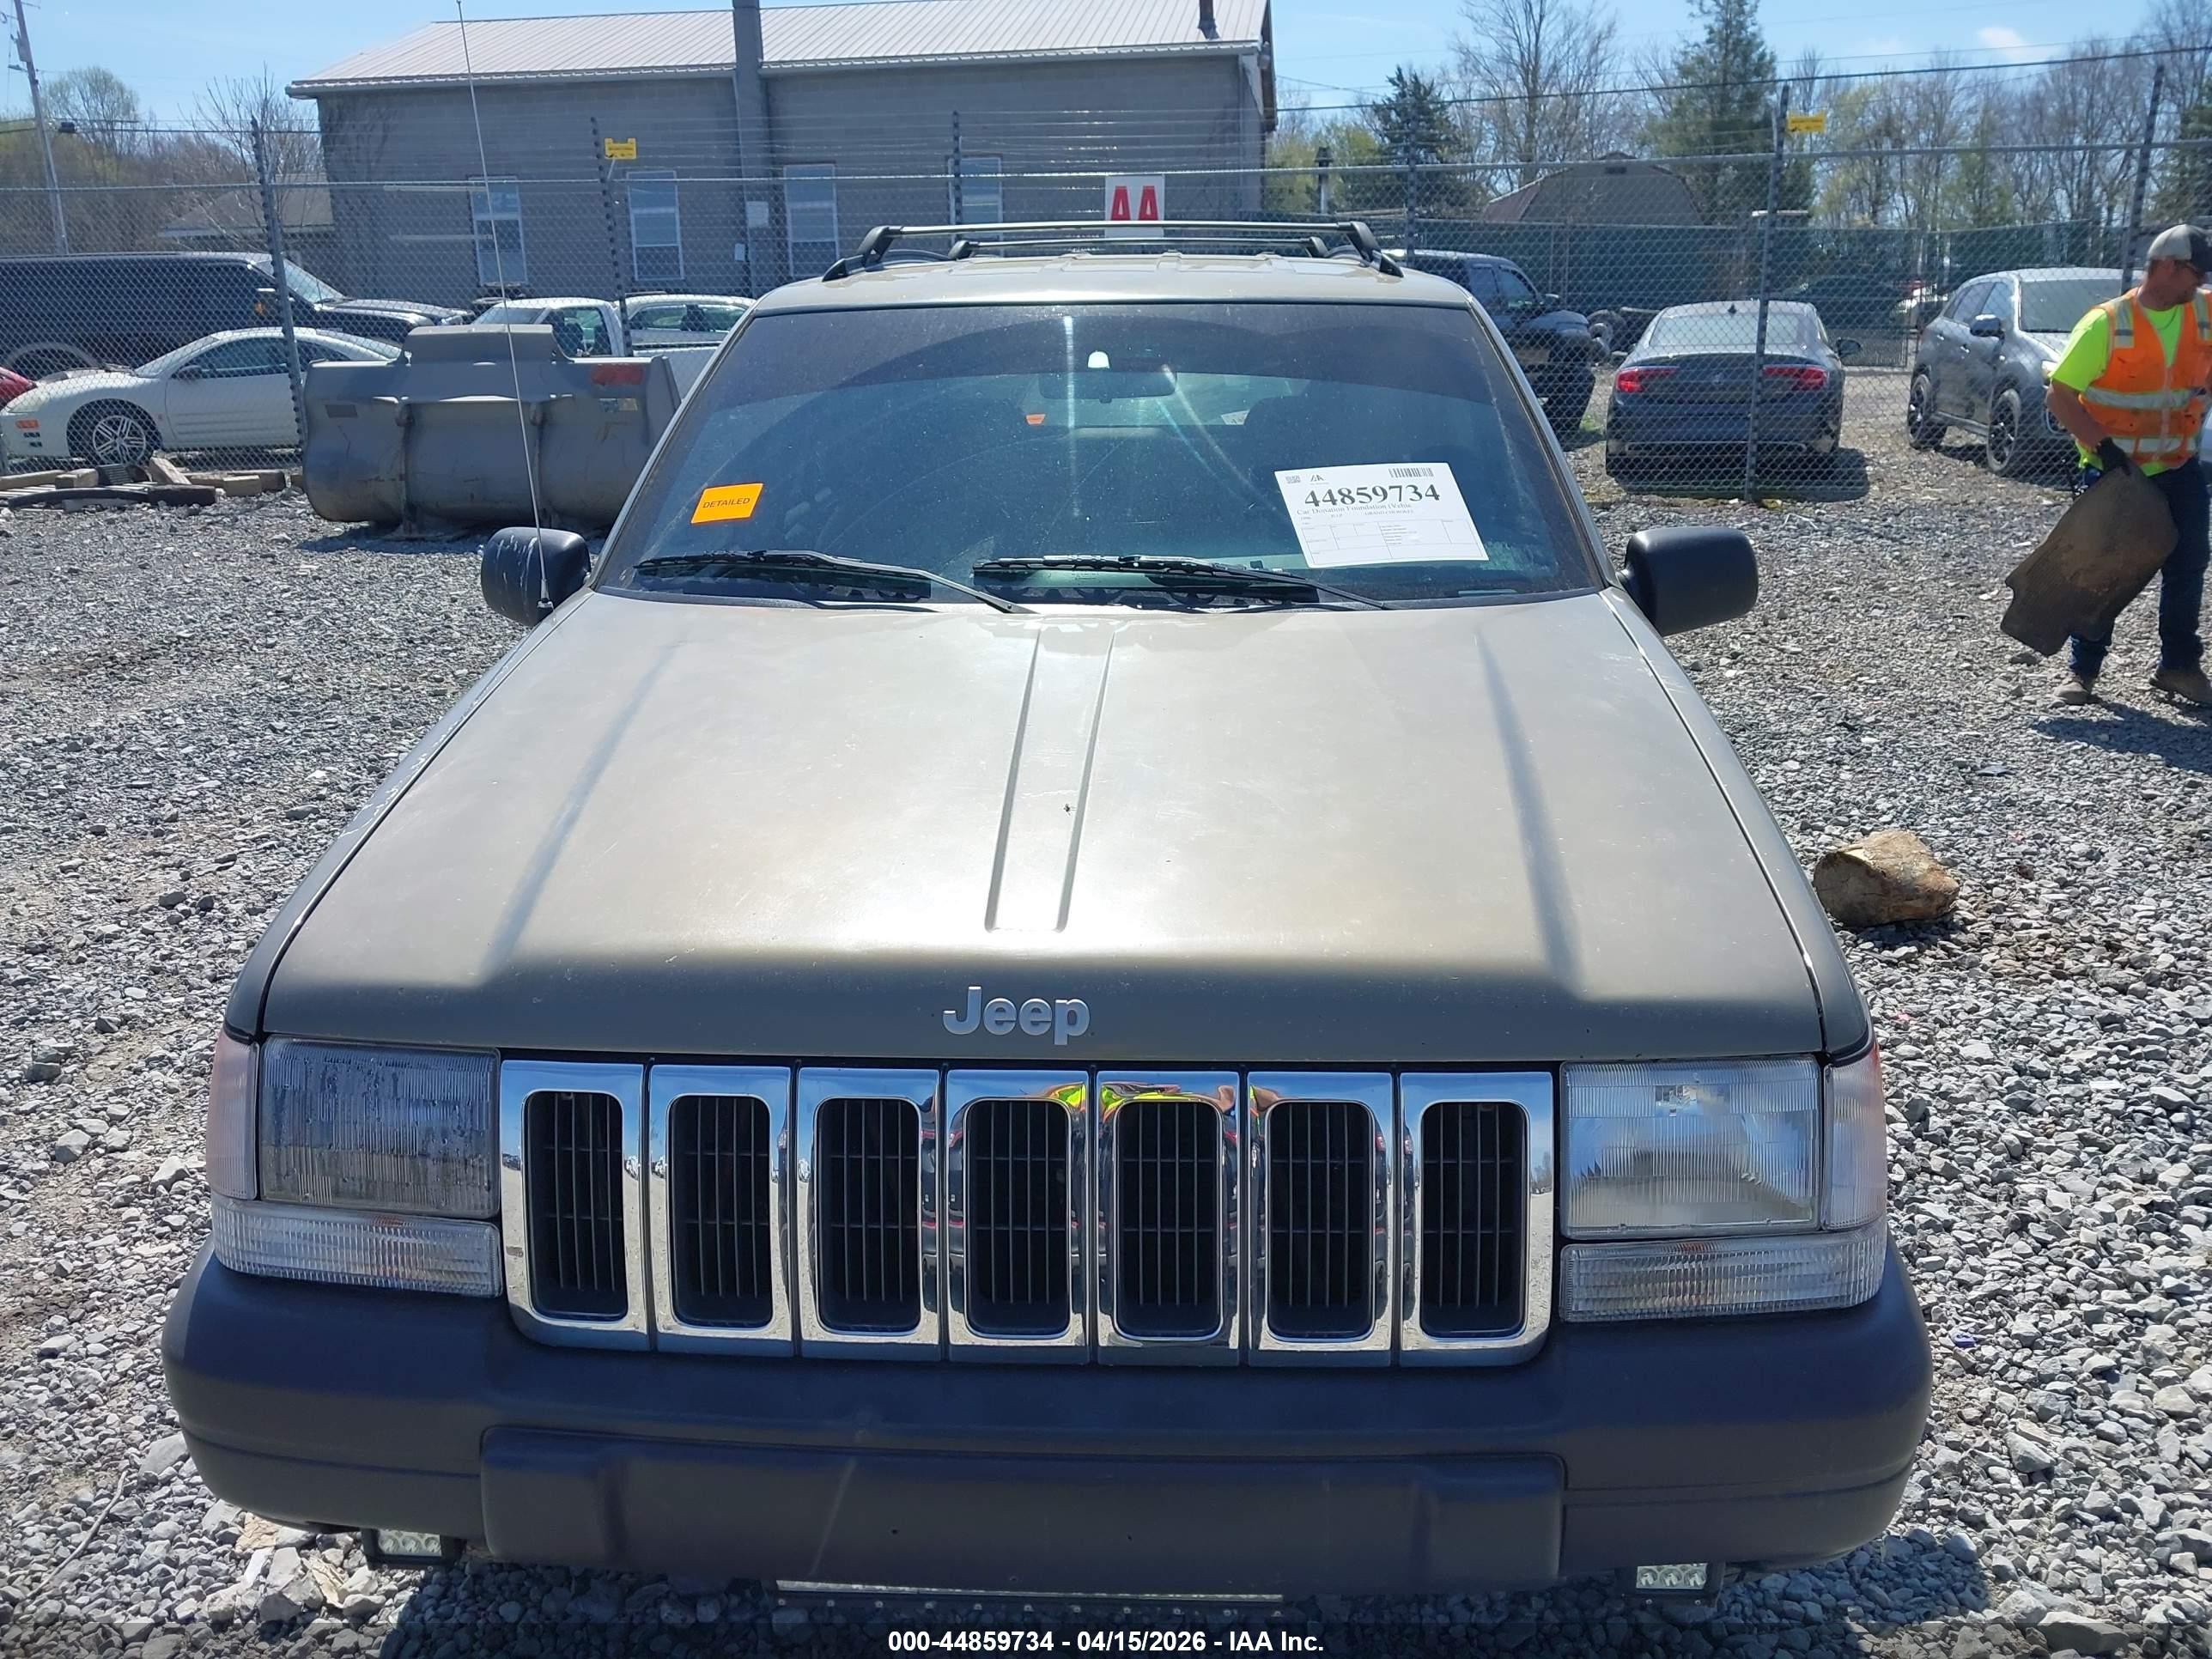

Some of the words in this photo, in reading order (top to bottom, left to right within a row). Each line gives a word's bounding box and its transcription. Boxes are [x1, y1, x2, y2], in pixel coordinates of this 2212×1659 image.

[702, 497, 751, 508] DETAILED
[1304, 483, 1441, 507] 44859734
[1346, 503, 1386, 513] Foundation
[943, 986, 1091, 1046] Jeep
